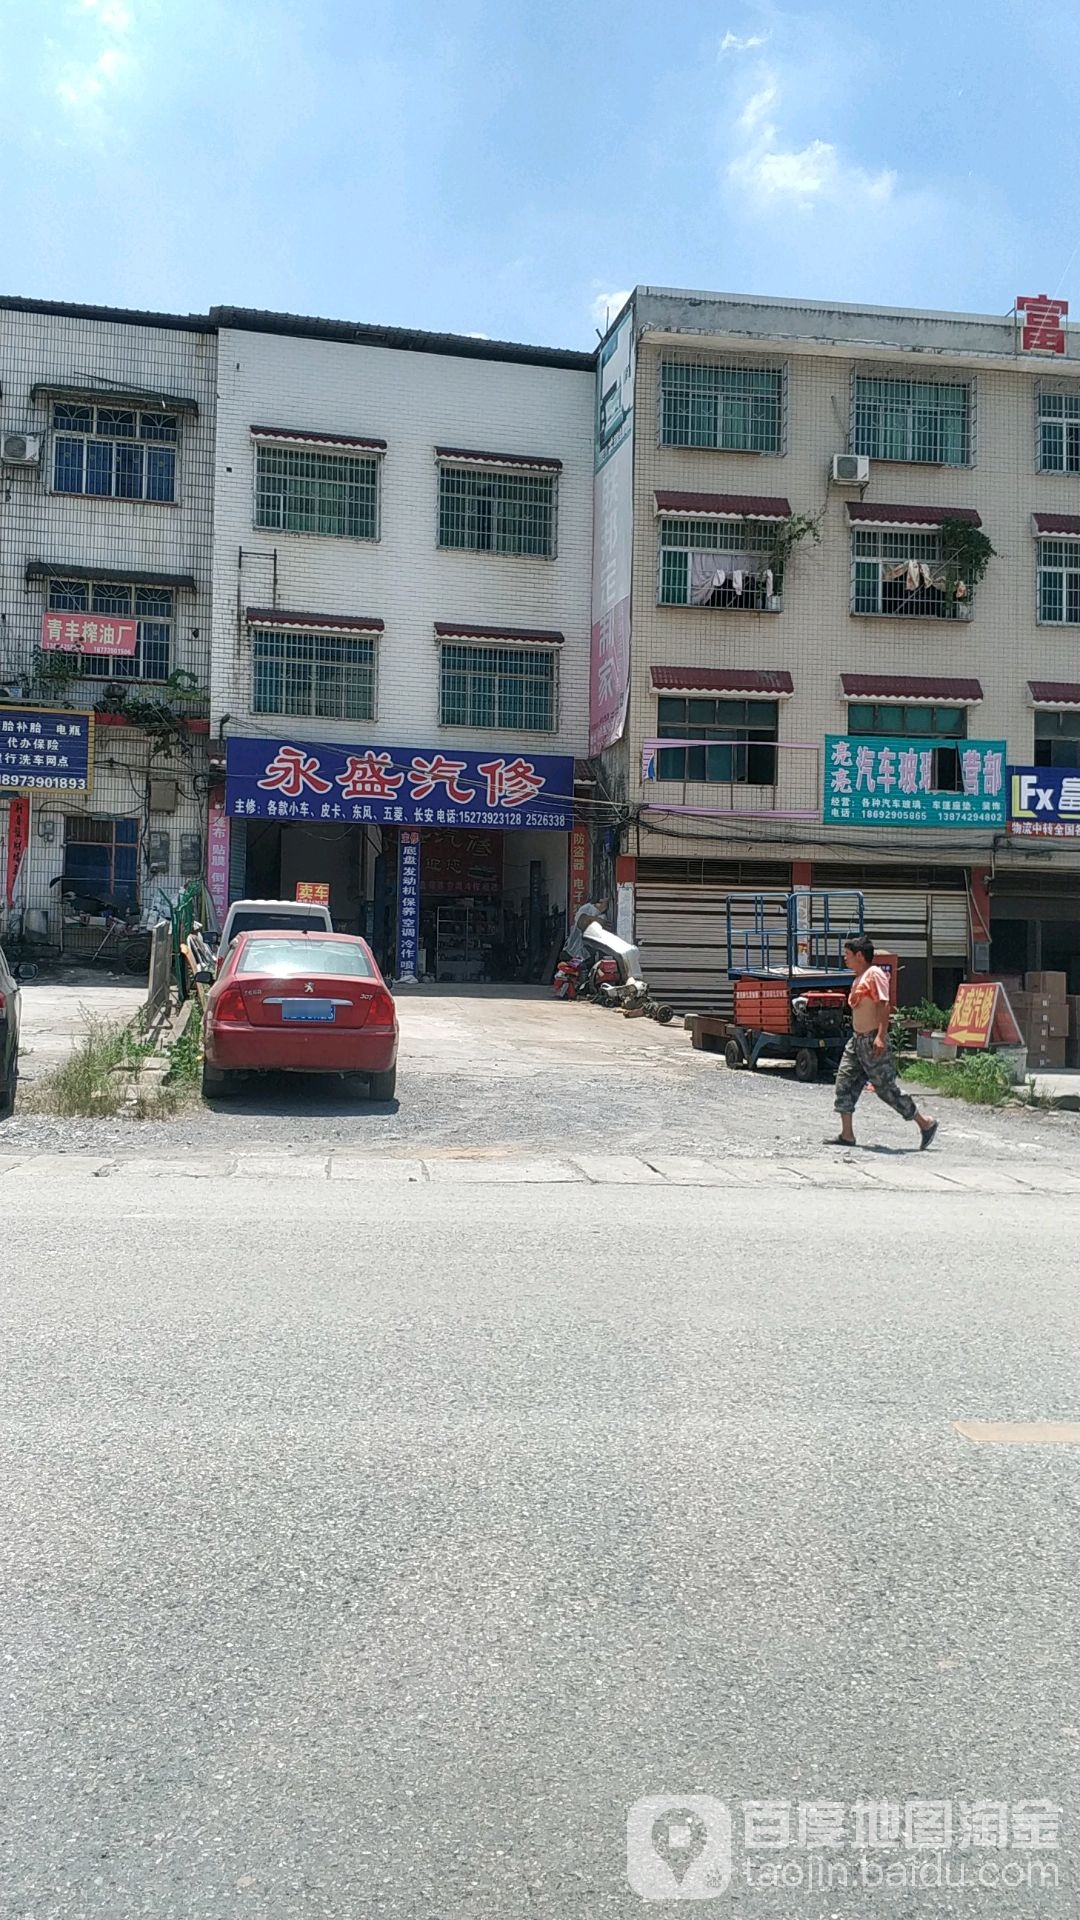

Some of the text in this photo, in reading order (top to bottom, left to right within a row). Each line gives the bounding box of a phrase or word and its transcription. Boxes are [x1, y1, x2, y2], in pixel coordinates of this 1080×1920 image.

[1016, 294, 1069, 354] 富
[47, 618, 132, 645] 青丰榨油厂
[2, 720, 81, 736] 胎补胎 电瓶
[8, 736, 59, 751] 代办保险
[0, 752, 69, 767] 行洗车网点
[257, 745, 546, 808] 永盛汽修
[856, 745, 1003, 797] 汽车玻营部
[526, 813, 566, 827] 2526338
[938, 812, 1003, 822] 13874294802
[400, 831, 419, 845] 主修
[402, 846, 417, 865] 底盘
[573, 832, 585, 871] 防盗器
[402, 866, 417, 896] 发动机
[298, 884, 329, 900] 卖车
[402, 897, 416, 917] 保养
[401, 918, 416, 938] 空调
[401, 939, 415, 959] 冷作
[949, 986, 995, 1029] 永盛汽修
